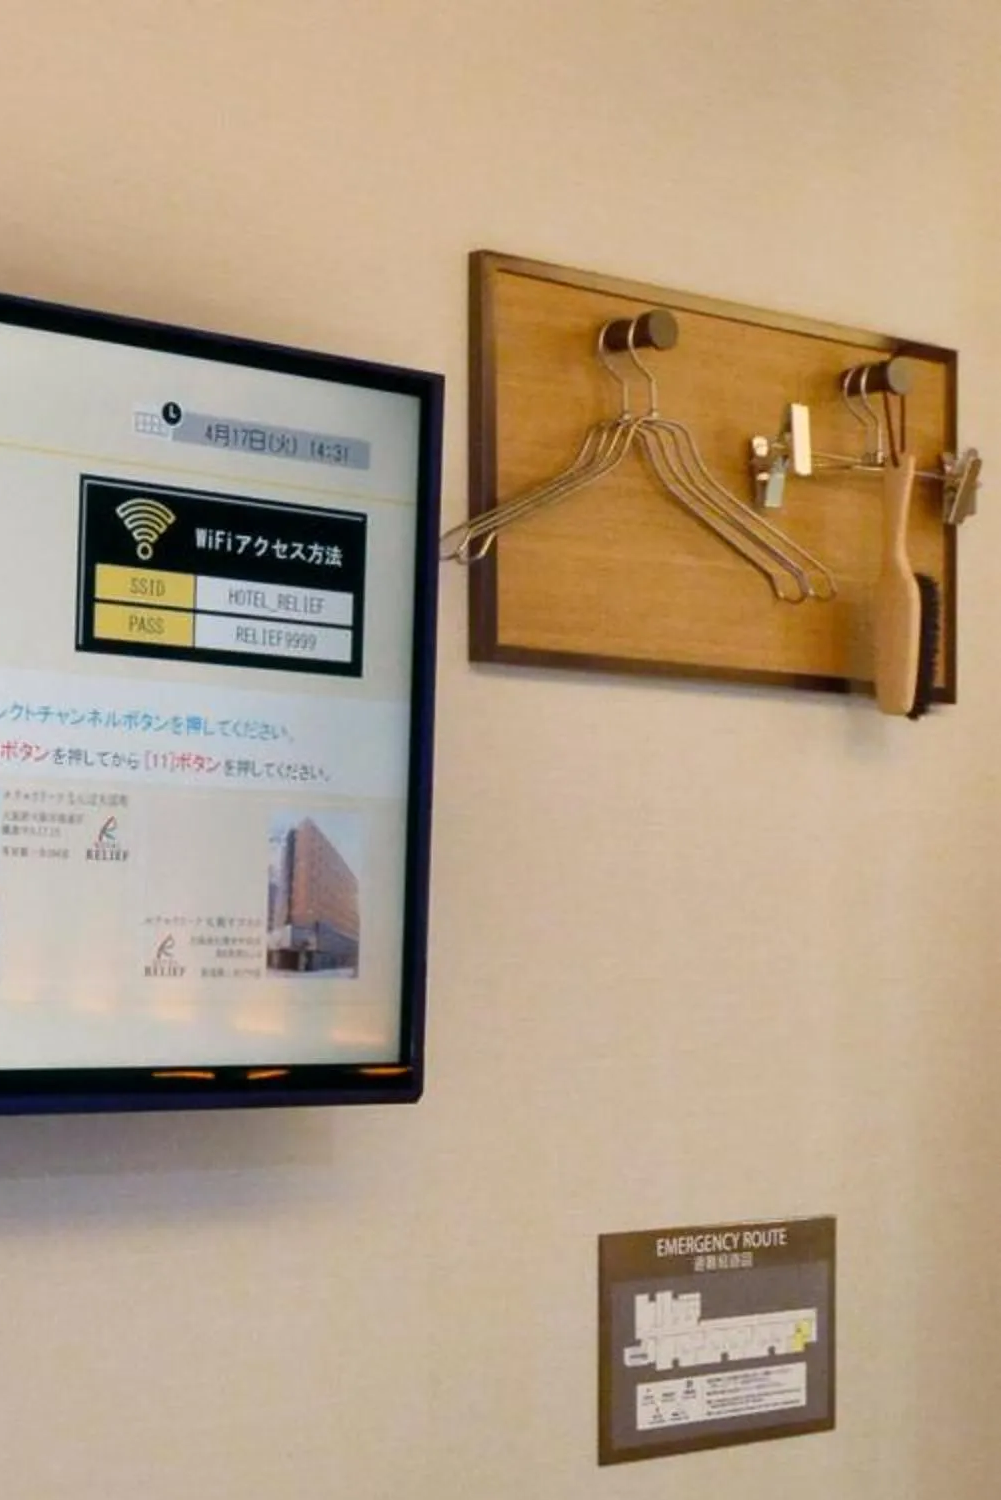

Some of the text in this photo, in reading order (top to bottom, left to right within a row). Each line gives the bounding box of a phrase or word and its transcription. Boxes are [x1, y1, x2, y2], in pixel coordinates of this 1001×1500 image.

[130, 578, 166, 596] SSID
[128, 615, 166, 635] PASS
[656, 1228, 788, 1256] EMERGENCY ROUTE
